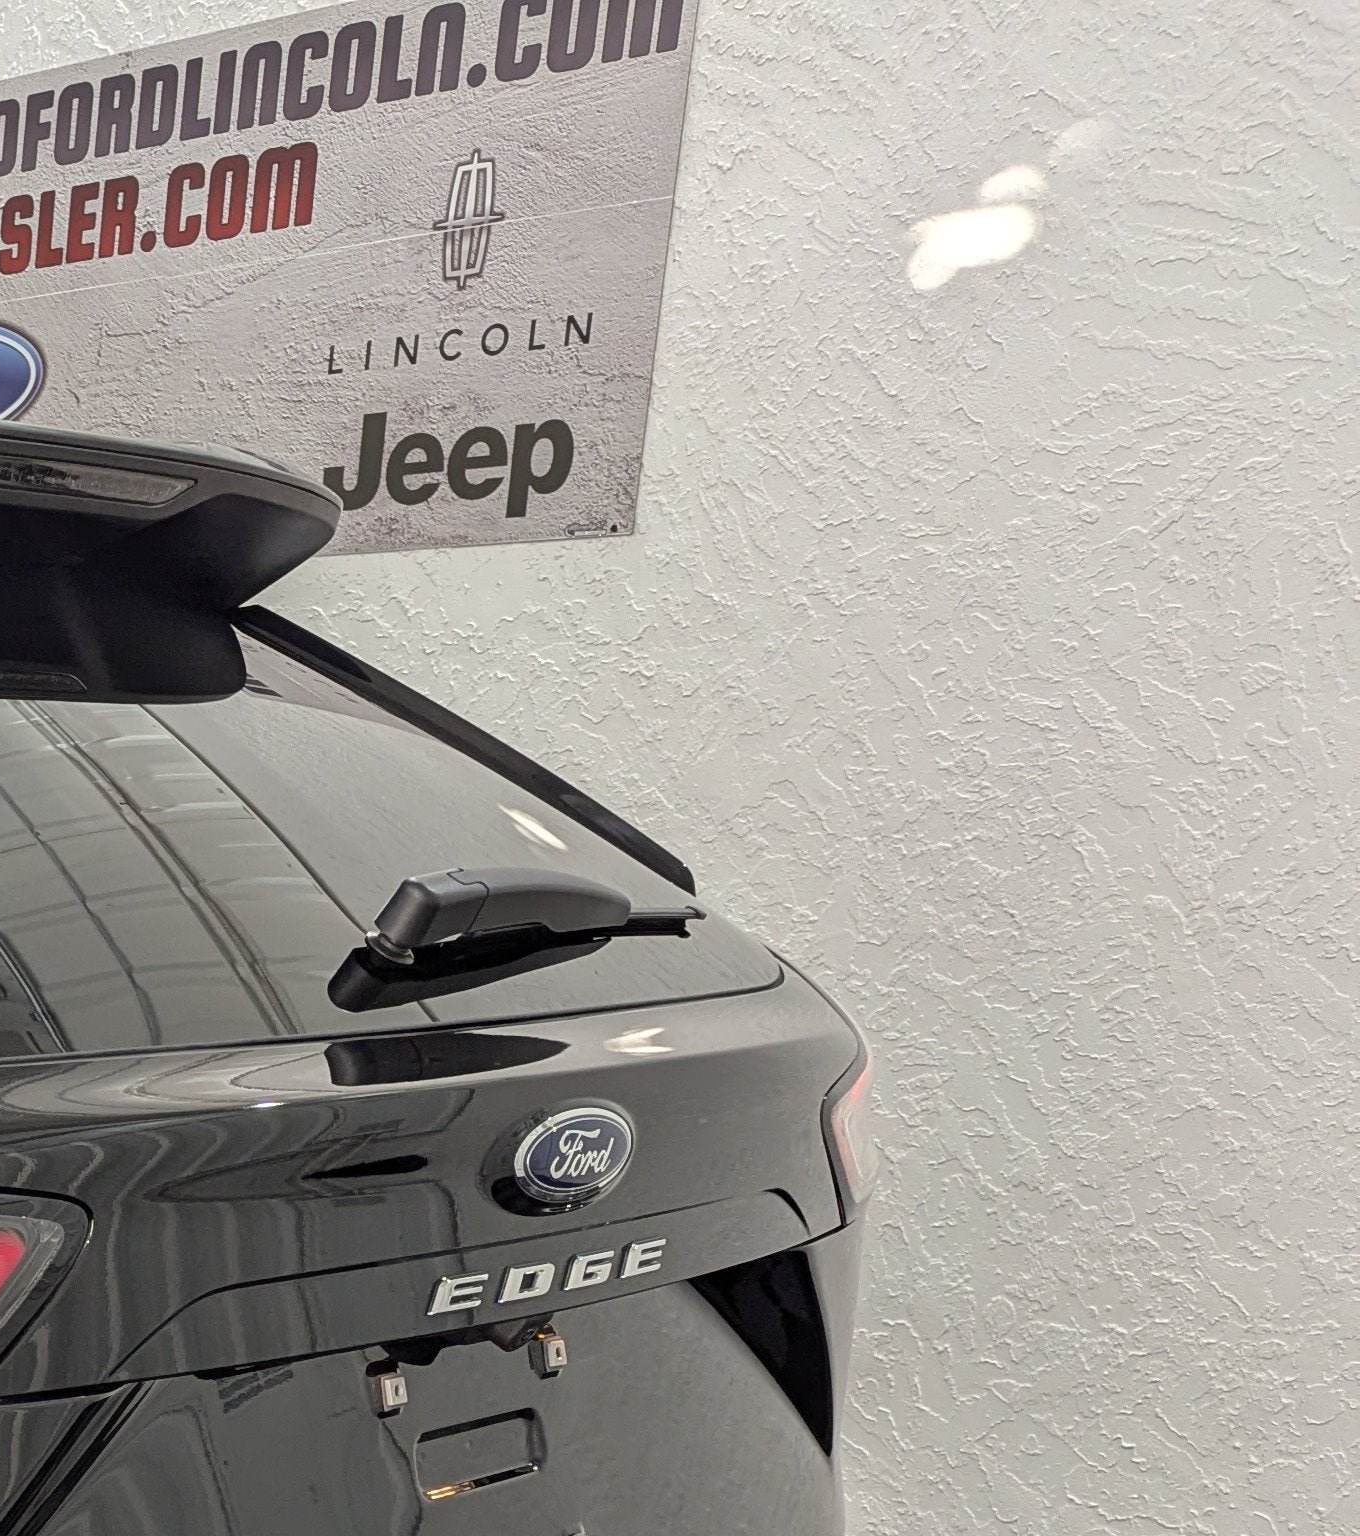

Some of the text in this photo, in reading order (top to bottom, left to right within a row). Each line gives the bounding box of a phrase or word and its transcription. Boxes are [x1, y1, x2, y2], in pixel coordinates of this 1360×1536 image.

[327, 312, 594, 375] LINCOLN
[323, 411, 575, 519] Jeep
[549, 1128, 615, 1180] Ford
[426, 1238, 667, 1316] EDGE
